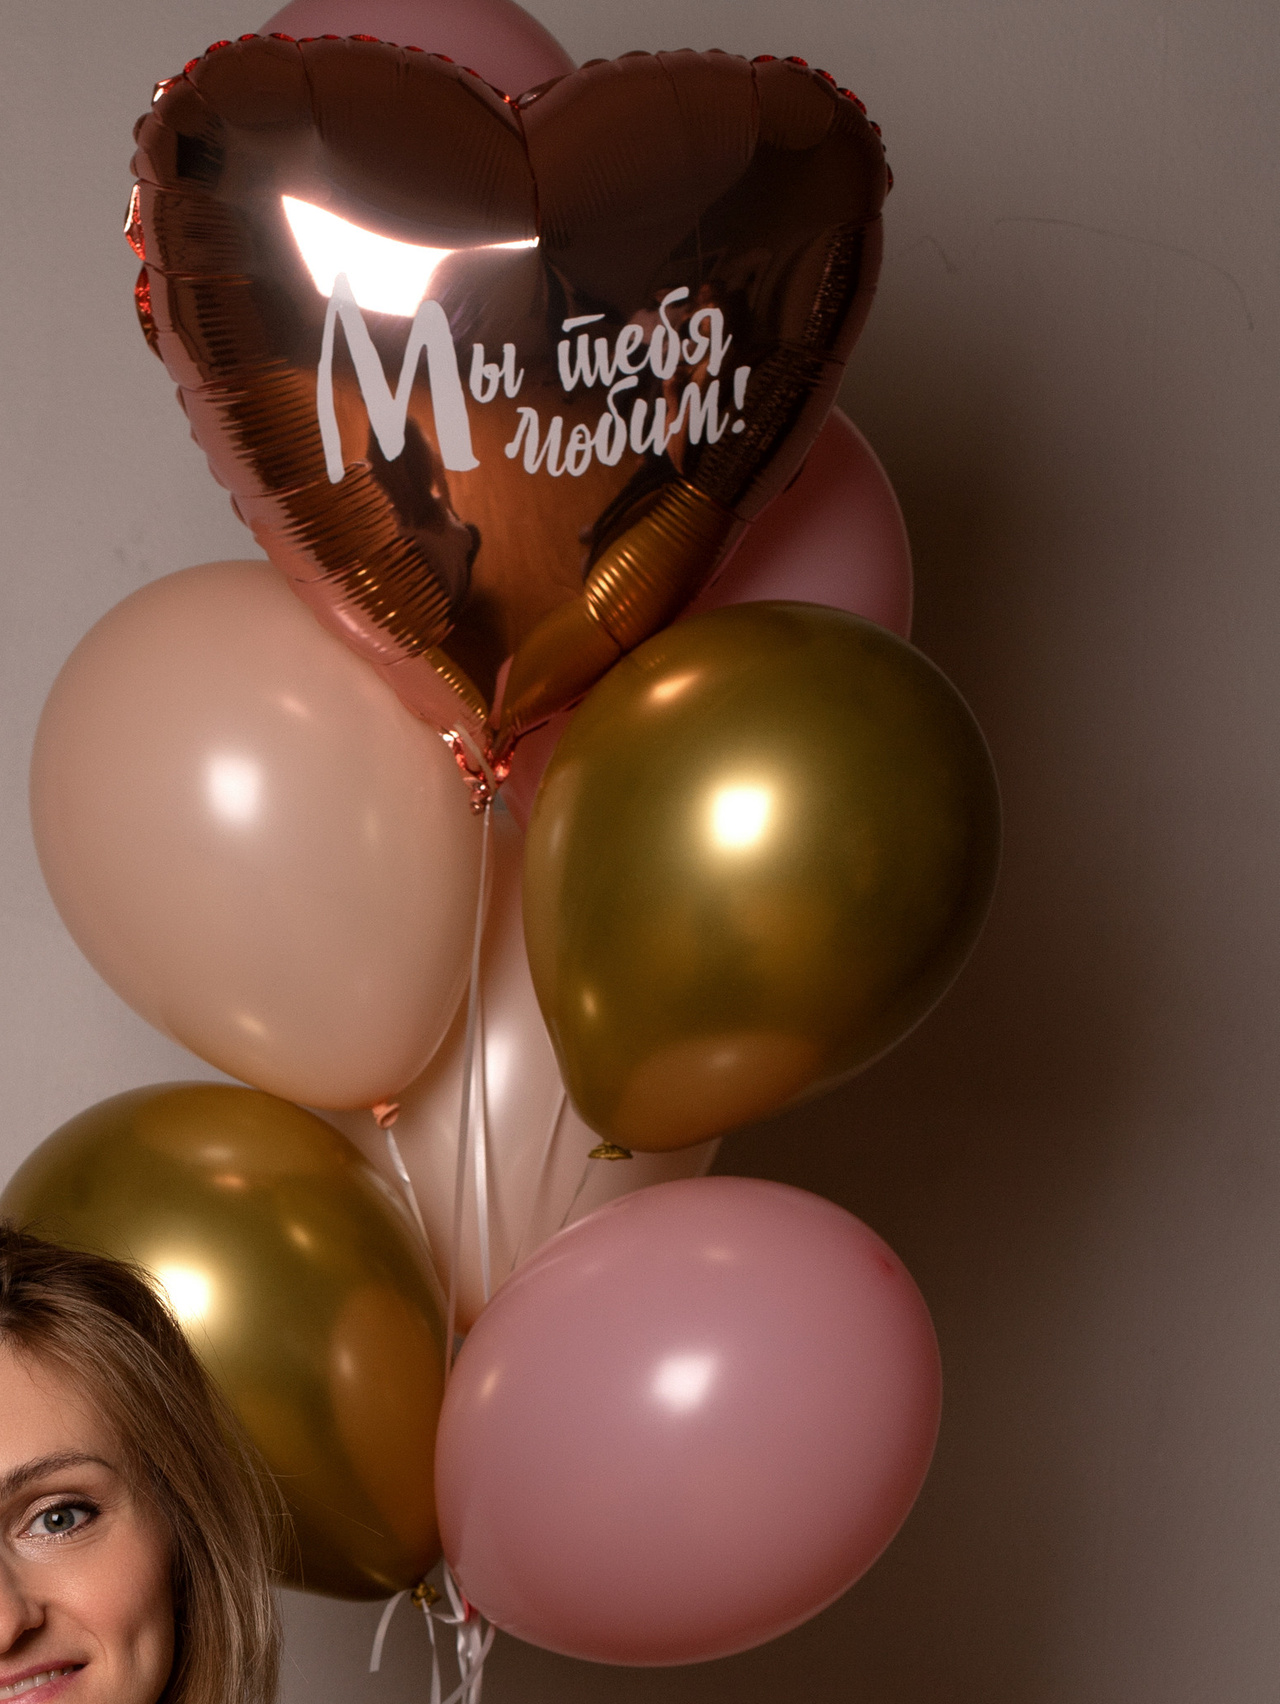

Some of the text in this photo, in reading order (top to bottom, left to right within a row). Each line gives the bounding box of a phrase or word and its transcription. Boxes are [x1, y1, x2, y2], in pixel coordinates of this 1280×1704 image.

[318, 273, 732, 484] Мы тебя
[504, 366, 752, 477] любим!
